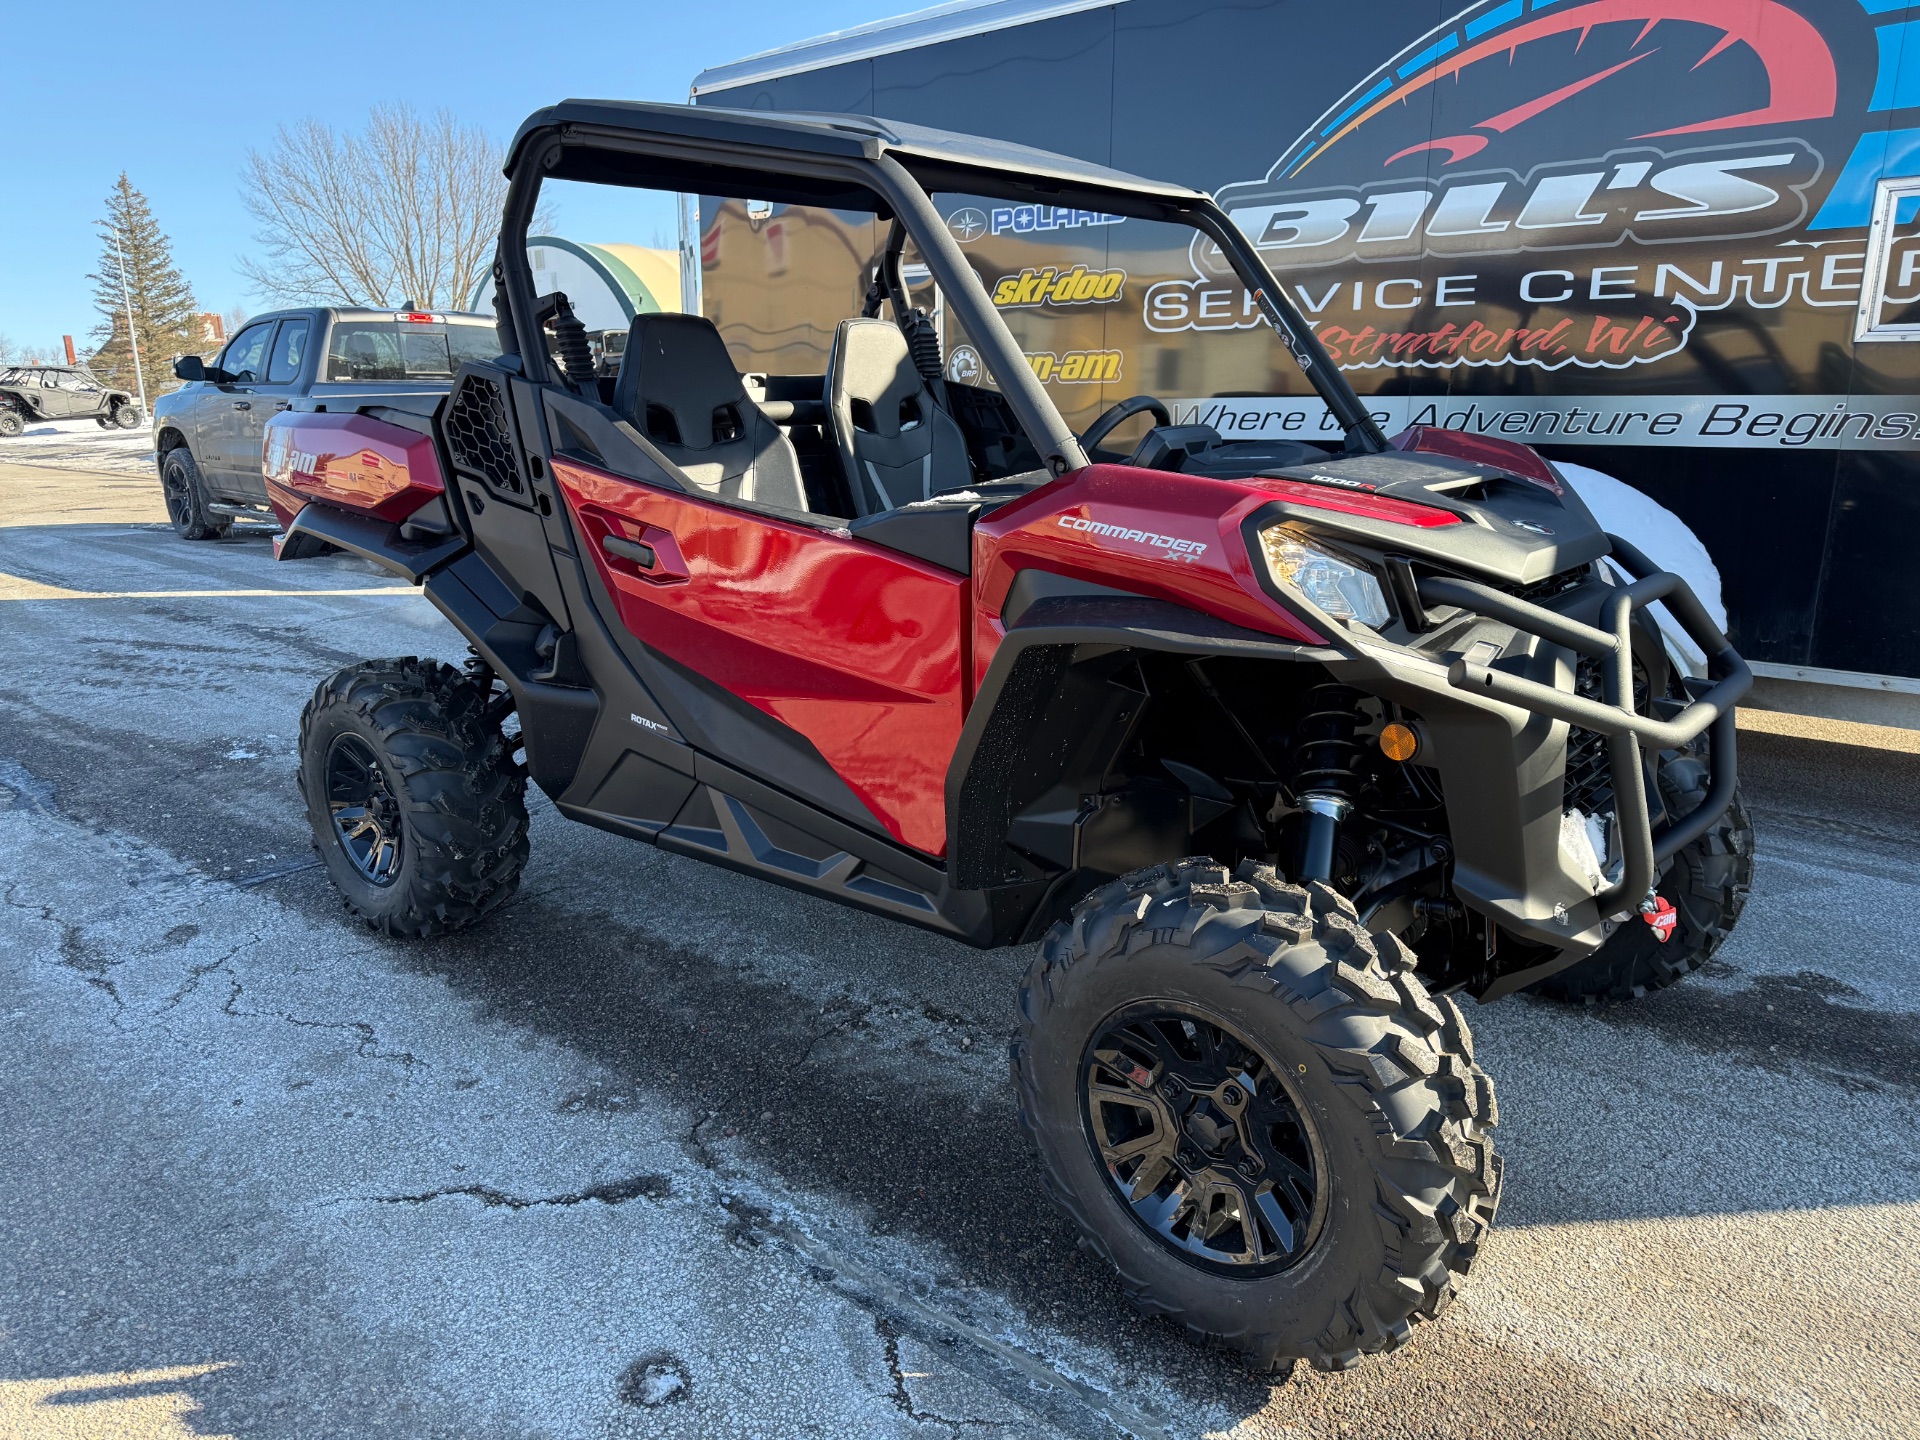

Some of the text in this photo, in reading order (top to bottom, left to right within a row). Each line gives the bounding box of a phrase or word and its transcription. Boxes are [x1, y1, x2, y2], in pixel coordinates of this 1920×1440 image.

[1210, 153, 1795, 254] BILL'S
[992, 269, 1123, 304] ski-doo
[1318, 317, 1574, 360] Stratford,
[961, 369, 978, 378] BRP
[989, 355, 1118, 380] n-am
[1173, 403, 1306, 431] Where
[1318, 407, 1391, 431] te
[1403, 402, 1683, 435] Adventure
[1311, 474, 1377, 490] 1000R
[1057, 515, 1208, 555] COMMANDER
[1162, 549, 1200, 563] XT
[630, 712, 657, 730] ROTAX
